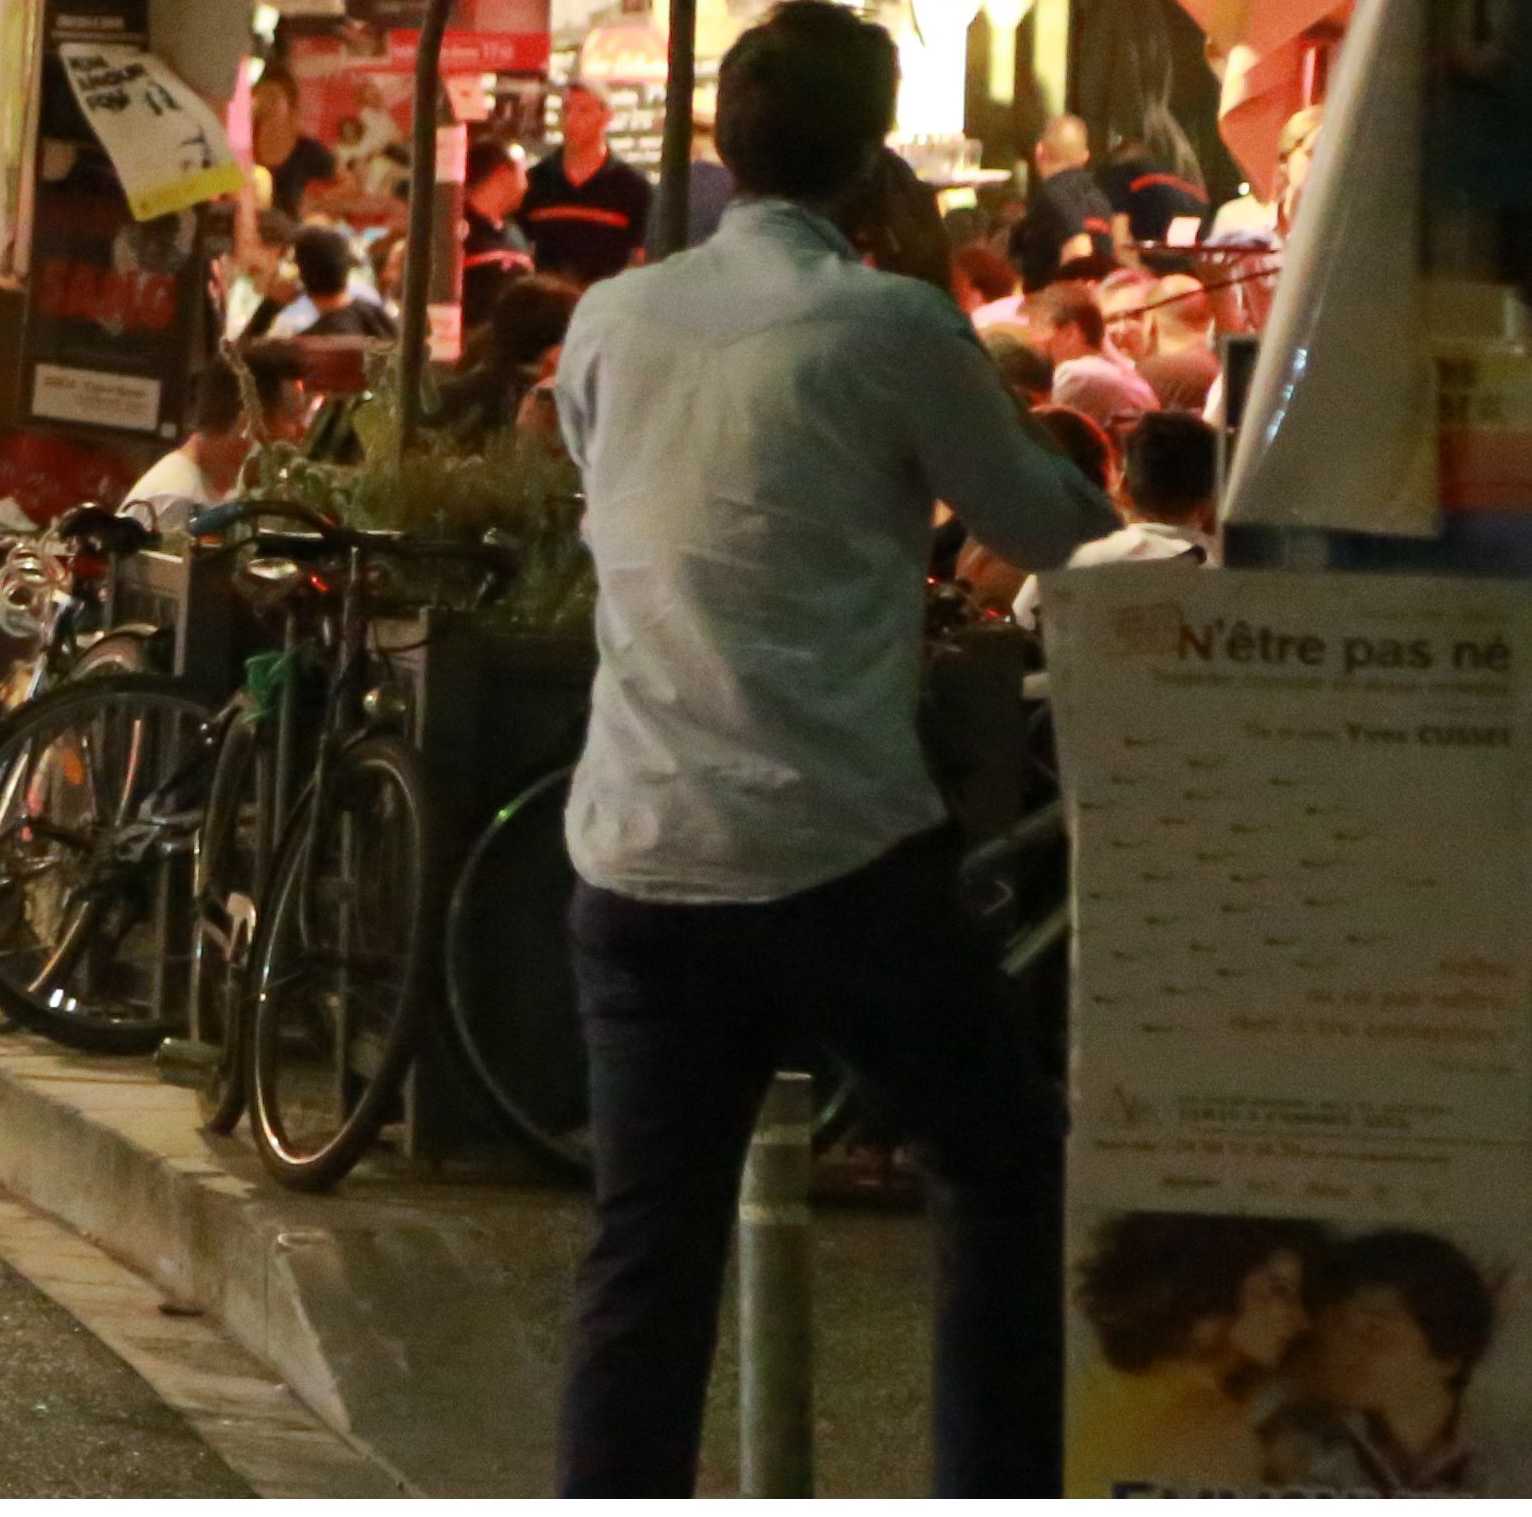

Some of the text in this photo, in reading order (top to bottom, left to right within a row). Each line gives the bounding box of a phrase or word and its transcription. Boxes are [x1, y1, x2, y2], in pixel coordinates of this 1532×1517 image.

[1177, 616, 1512, 674] N'être pas né
